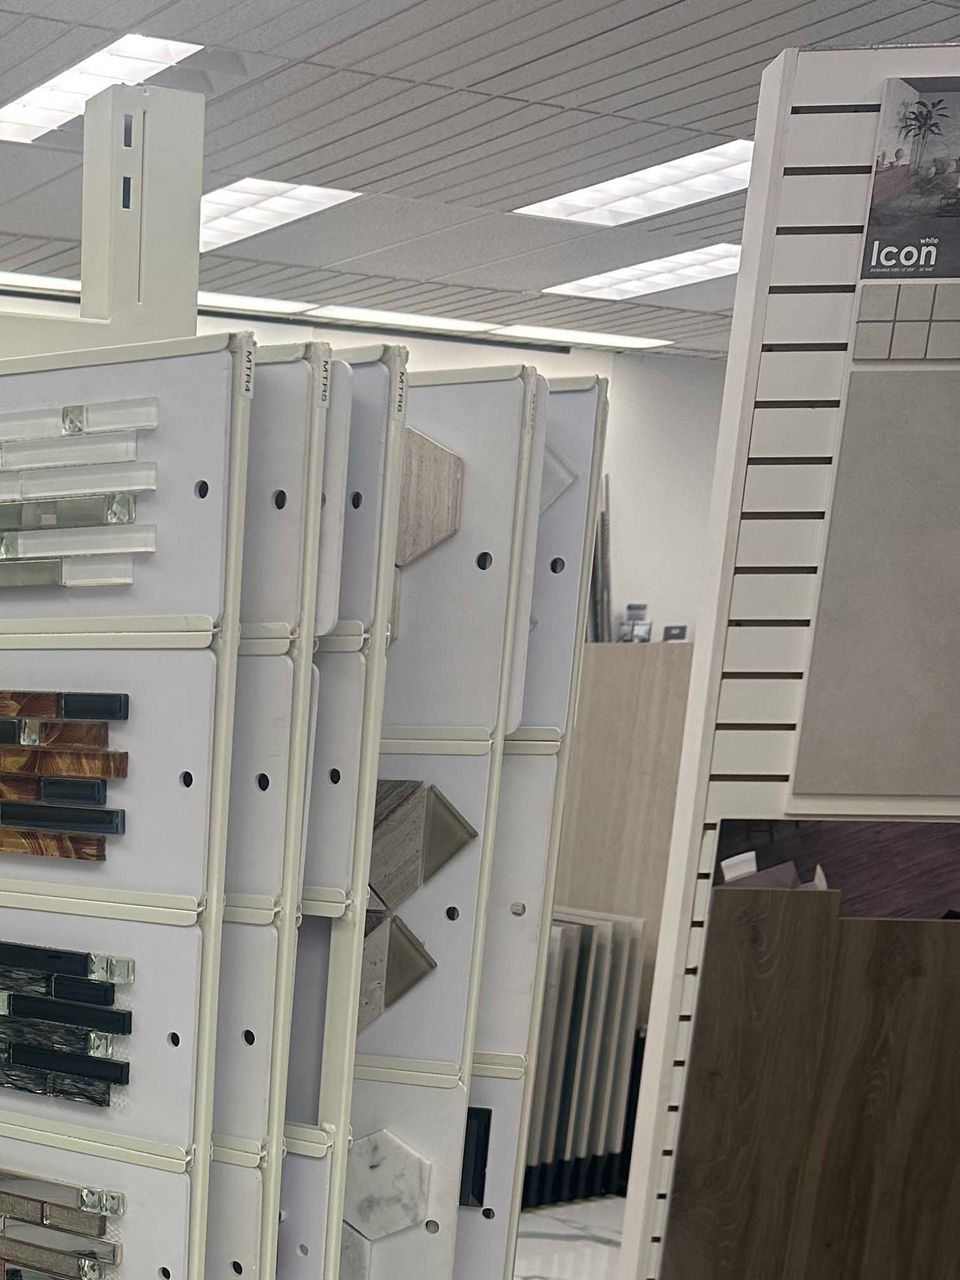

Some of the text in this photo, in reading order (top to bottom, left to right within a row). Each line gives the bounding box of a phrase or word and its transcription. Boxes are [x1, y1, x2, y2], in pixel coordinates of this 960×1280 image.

[871, 240, 937, 266] Icon
[243, 350, 253, 392] MTR4
[321, 360, 329, 402] MTR5
